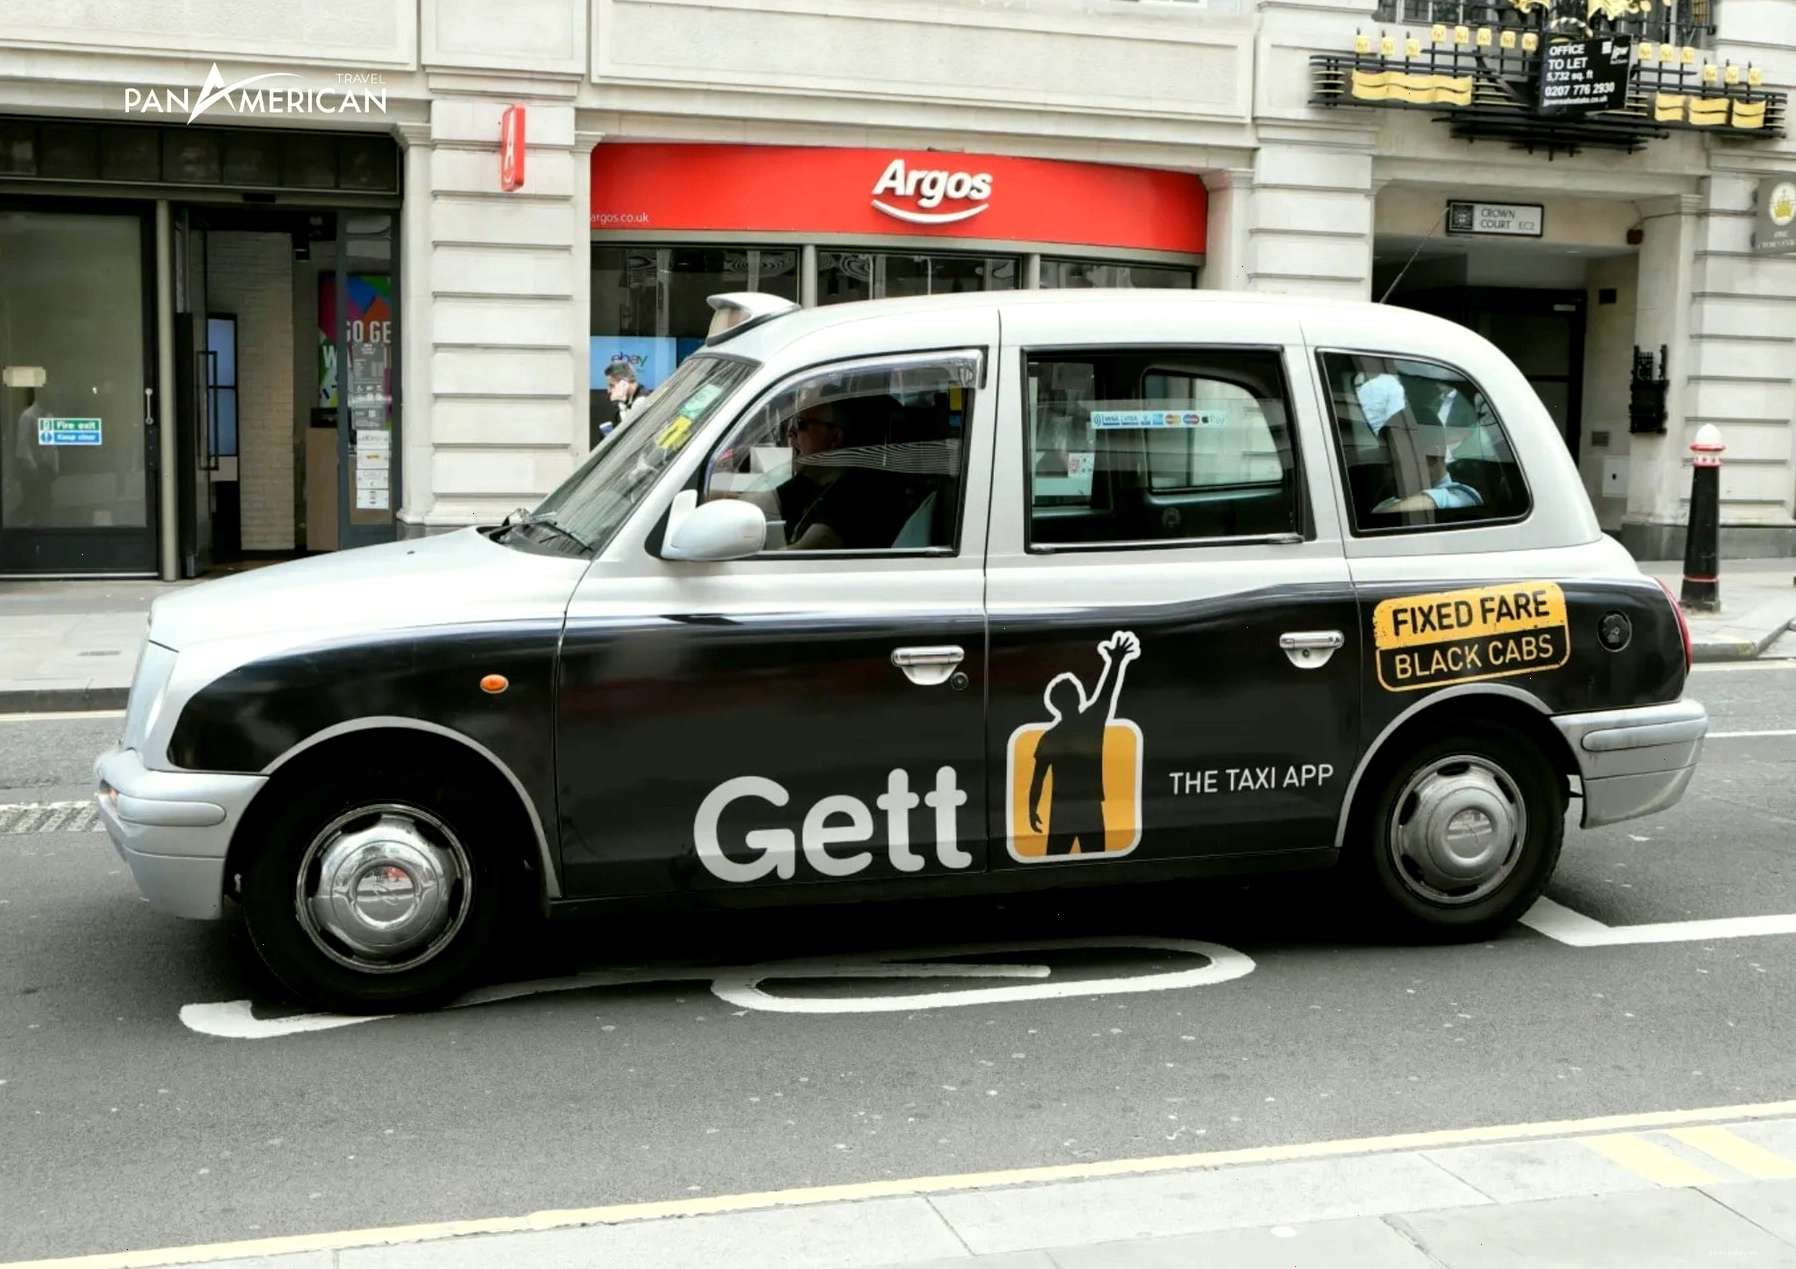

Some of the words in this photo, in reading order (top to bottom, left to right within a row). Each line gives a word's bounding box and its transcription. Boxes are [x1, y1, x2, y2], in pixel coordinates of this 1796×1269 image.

[1549, 44, 1586, 56] OFFICE
[1548, 59, 1564, 70] TO
[1567, 57, 1588, 69] LET
[1545, 85, 1571, 97] 0207
[871, 158, 993, 209] Argos
[590, 211, 649, 225] argos.co.uk
[1481, 208, 1515, 219] CROWN
[1481, 219, 1511, 229] COURT
[1518, 221, 1535, 230] EC2
[611, 351, 648, 367] ebay
[56, 421, 75, 430] Fire
[78, 421, 96, 430] exit
[1392, 600, 1473, 636] FIXED
[1479, 590, 1550, 624] FARE
[1395, 643, 1482, 679] BLACK
[1488, 634, 1554, 666] CABS
[1169, 770, 1218, 795] THE
[1225, 766, 1276, 792] TAXI
[1282, 764, 1334, 788] APP
[693, 765, 973, 883] Gett
